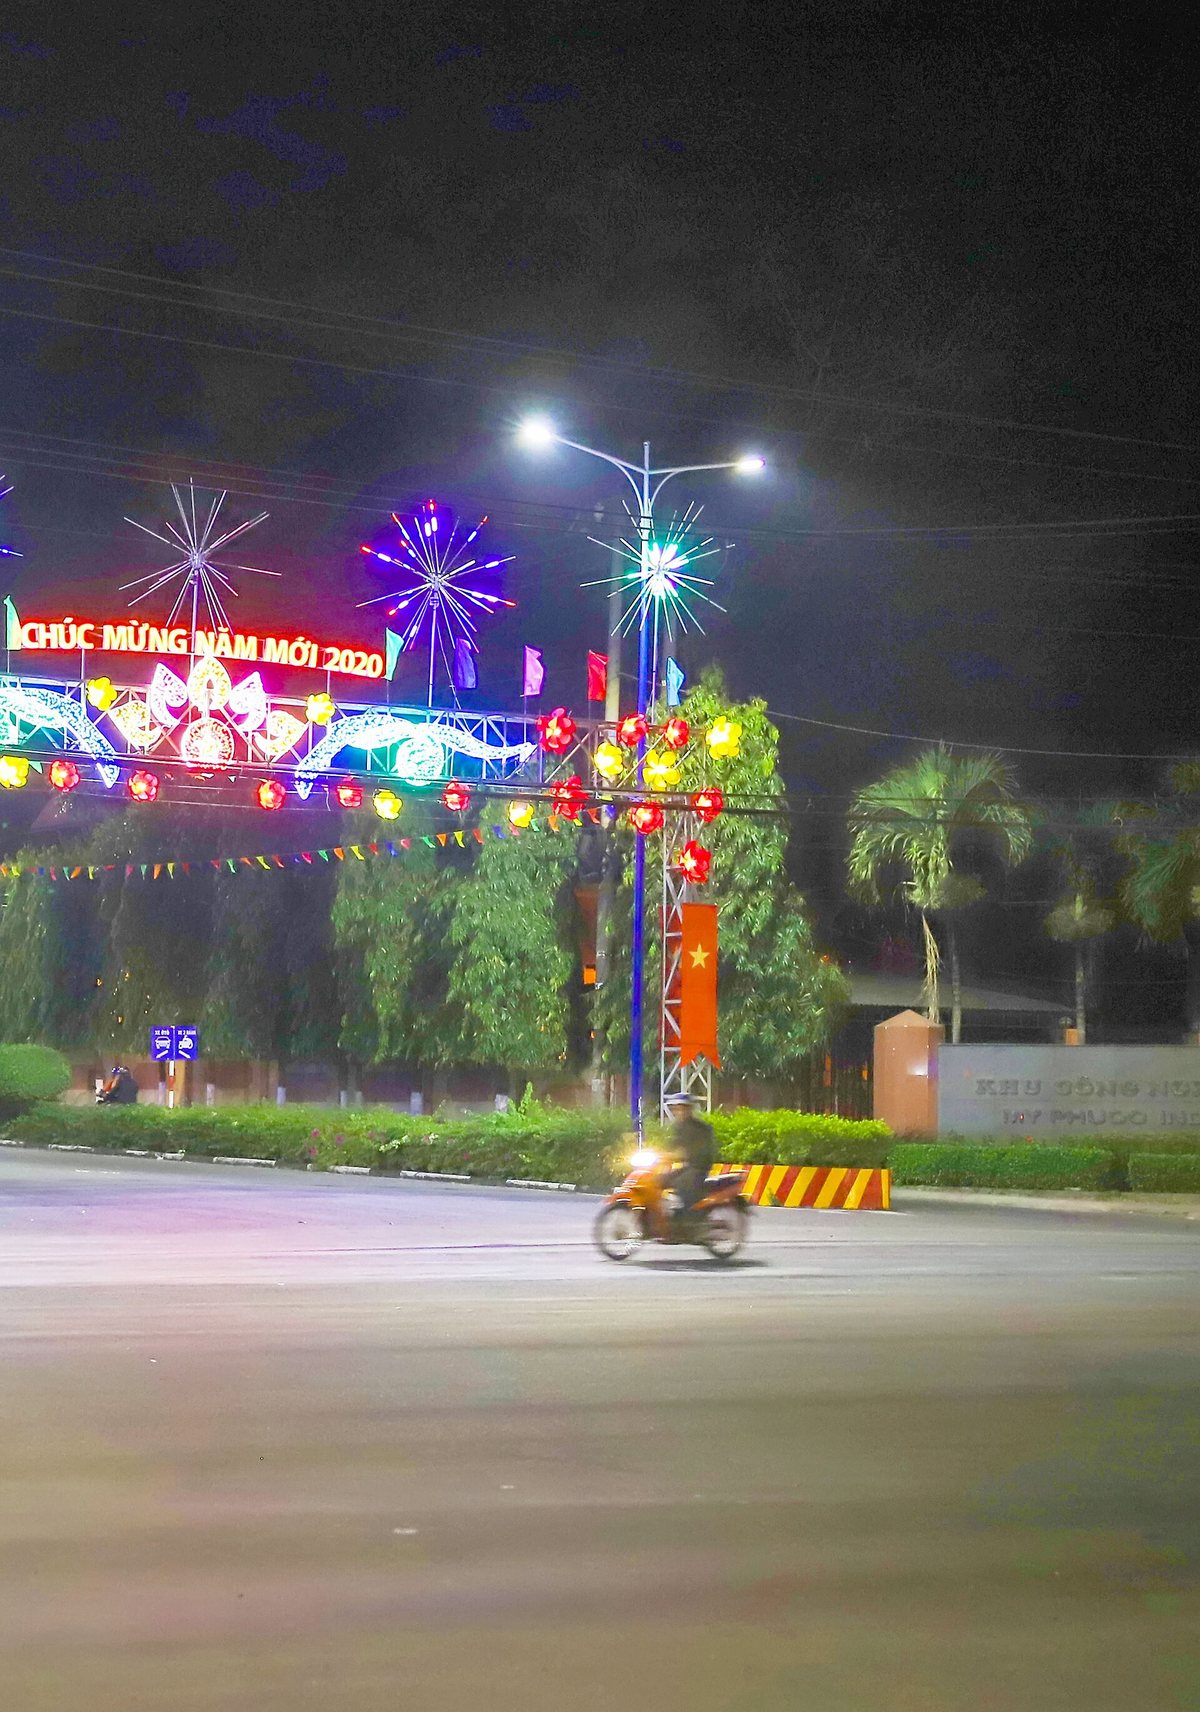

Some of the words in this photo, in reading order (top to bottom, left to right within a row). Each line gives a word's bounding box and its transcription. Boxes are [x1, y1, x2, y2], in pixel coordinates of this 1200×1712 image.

[21, 617, 95, 650] CHÚC
[102, 619, 188, 653] MỪNG
[195, 626, 258, 661] NĂM
[263, 636, 319, 669] MỚI
[323, 647, 383, 679] 2020
